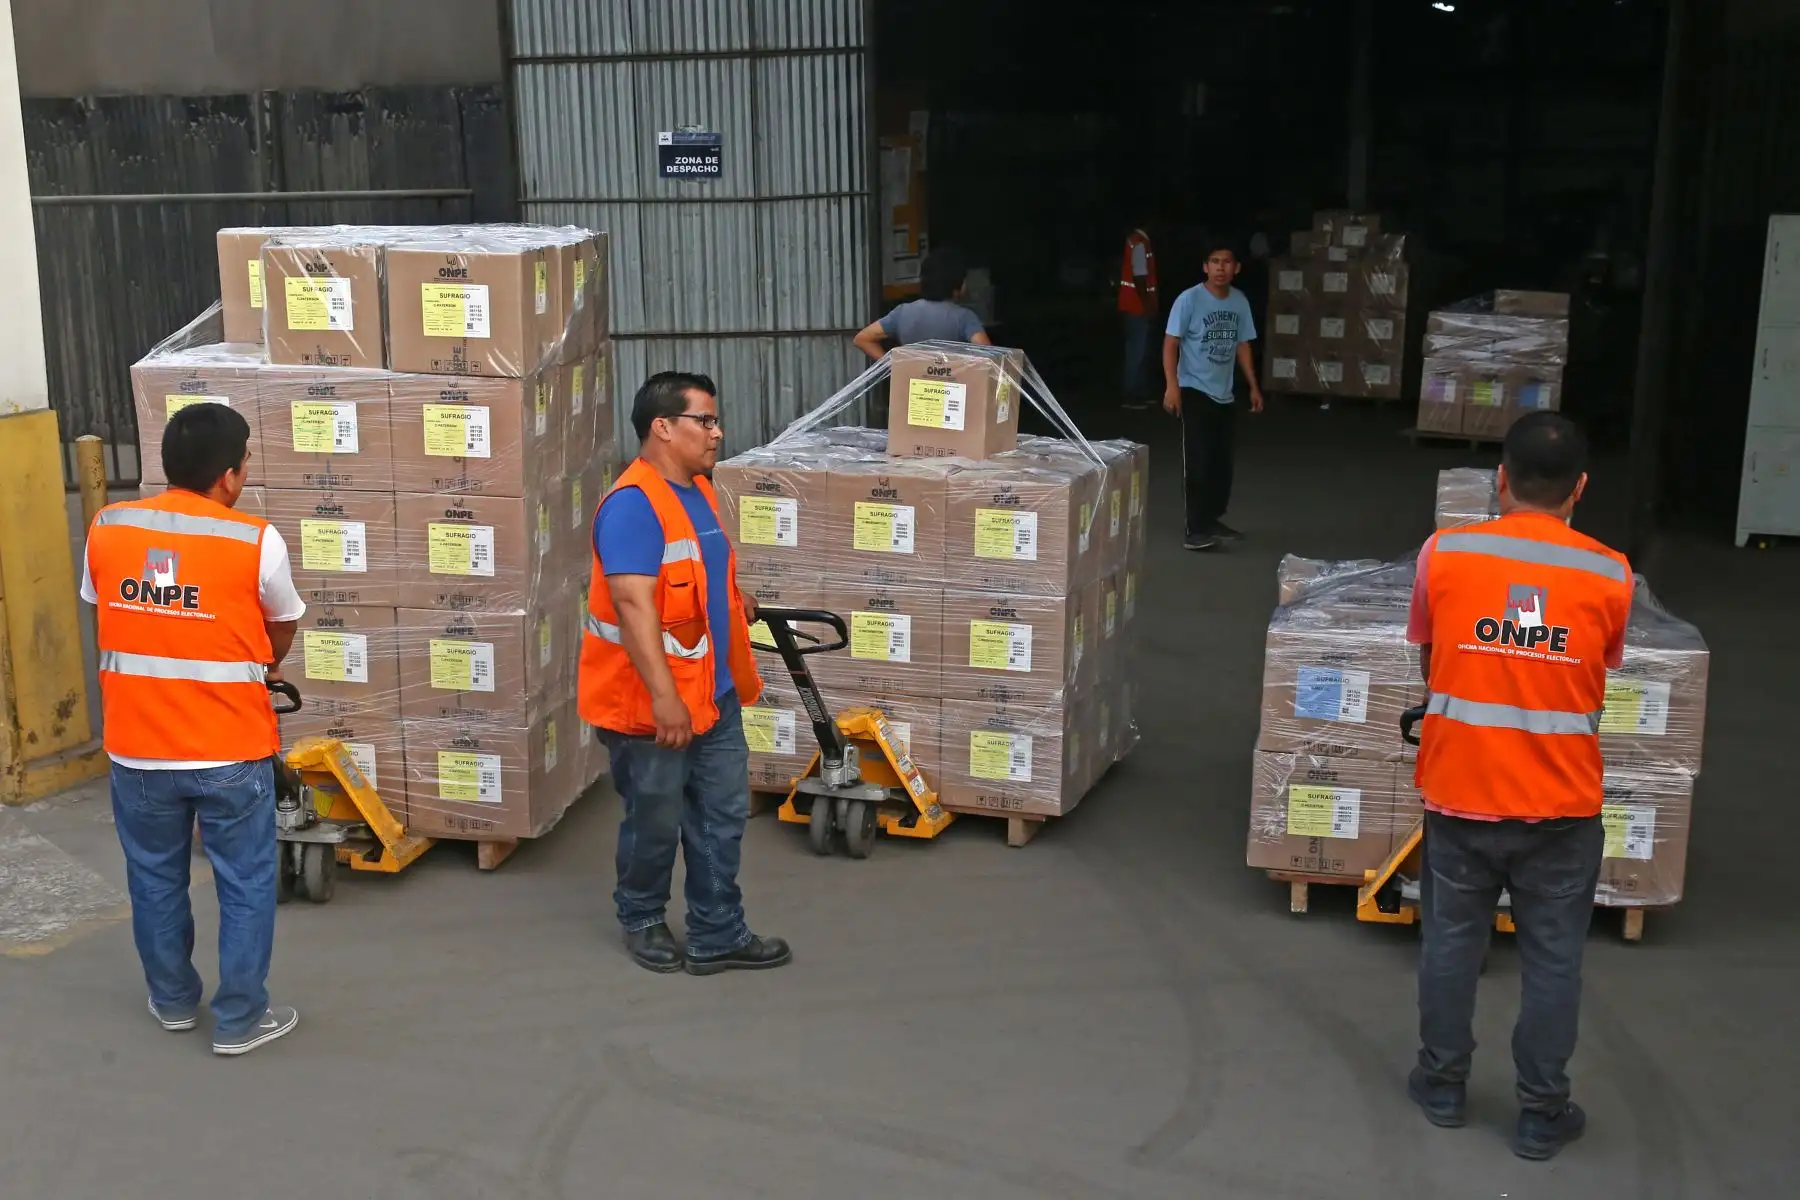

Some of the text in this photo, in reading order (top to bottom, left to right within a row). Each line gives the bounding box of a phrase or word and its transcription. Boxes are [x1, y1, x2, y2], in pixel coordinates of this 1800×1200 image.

[675, 156, 719, 164] ZONA DE
[666, 165, 719, 173] DESPACHO
[438, 268, 468, 278] ONPE
[927, 366, 952, 377] ONPE
[924, 387, 951, 396] SUFRAGIO
[440, 412, 472, 420] SUFRAGIO
[755, 482, 781, 492] ONPE
[871, 488, 898, 498] ONPE
[445, 509, 473, 519] ONPE
[119, 578, 200, 610] ONPE
[123, 603, 145, 611] NACIONAL
[154, 607, 180, 616] PROCESOS
[181, 611, 216, 619] ELECTORALES
[986, 629, 1016, 637] SUFRAGIO
[1475, 617, 1569, 653] ONPE
[1478, 645, 1506, 654] NACIONAL
[1516, 649, 1545, 659] PROCESOS
[1546, 654, 1581, 664] ELECTORALES
[1307, 793, 1341, 801] SUFRAGIO
